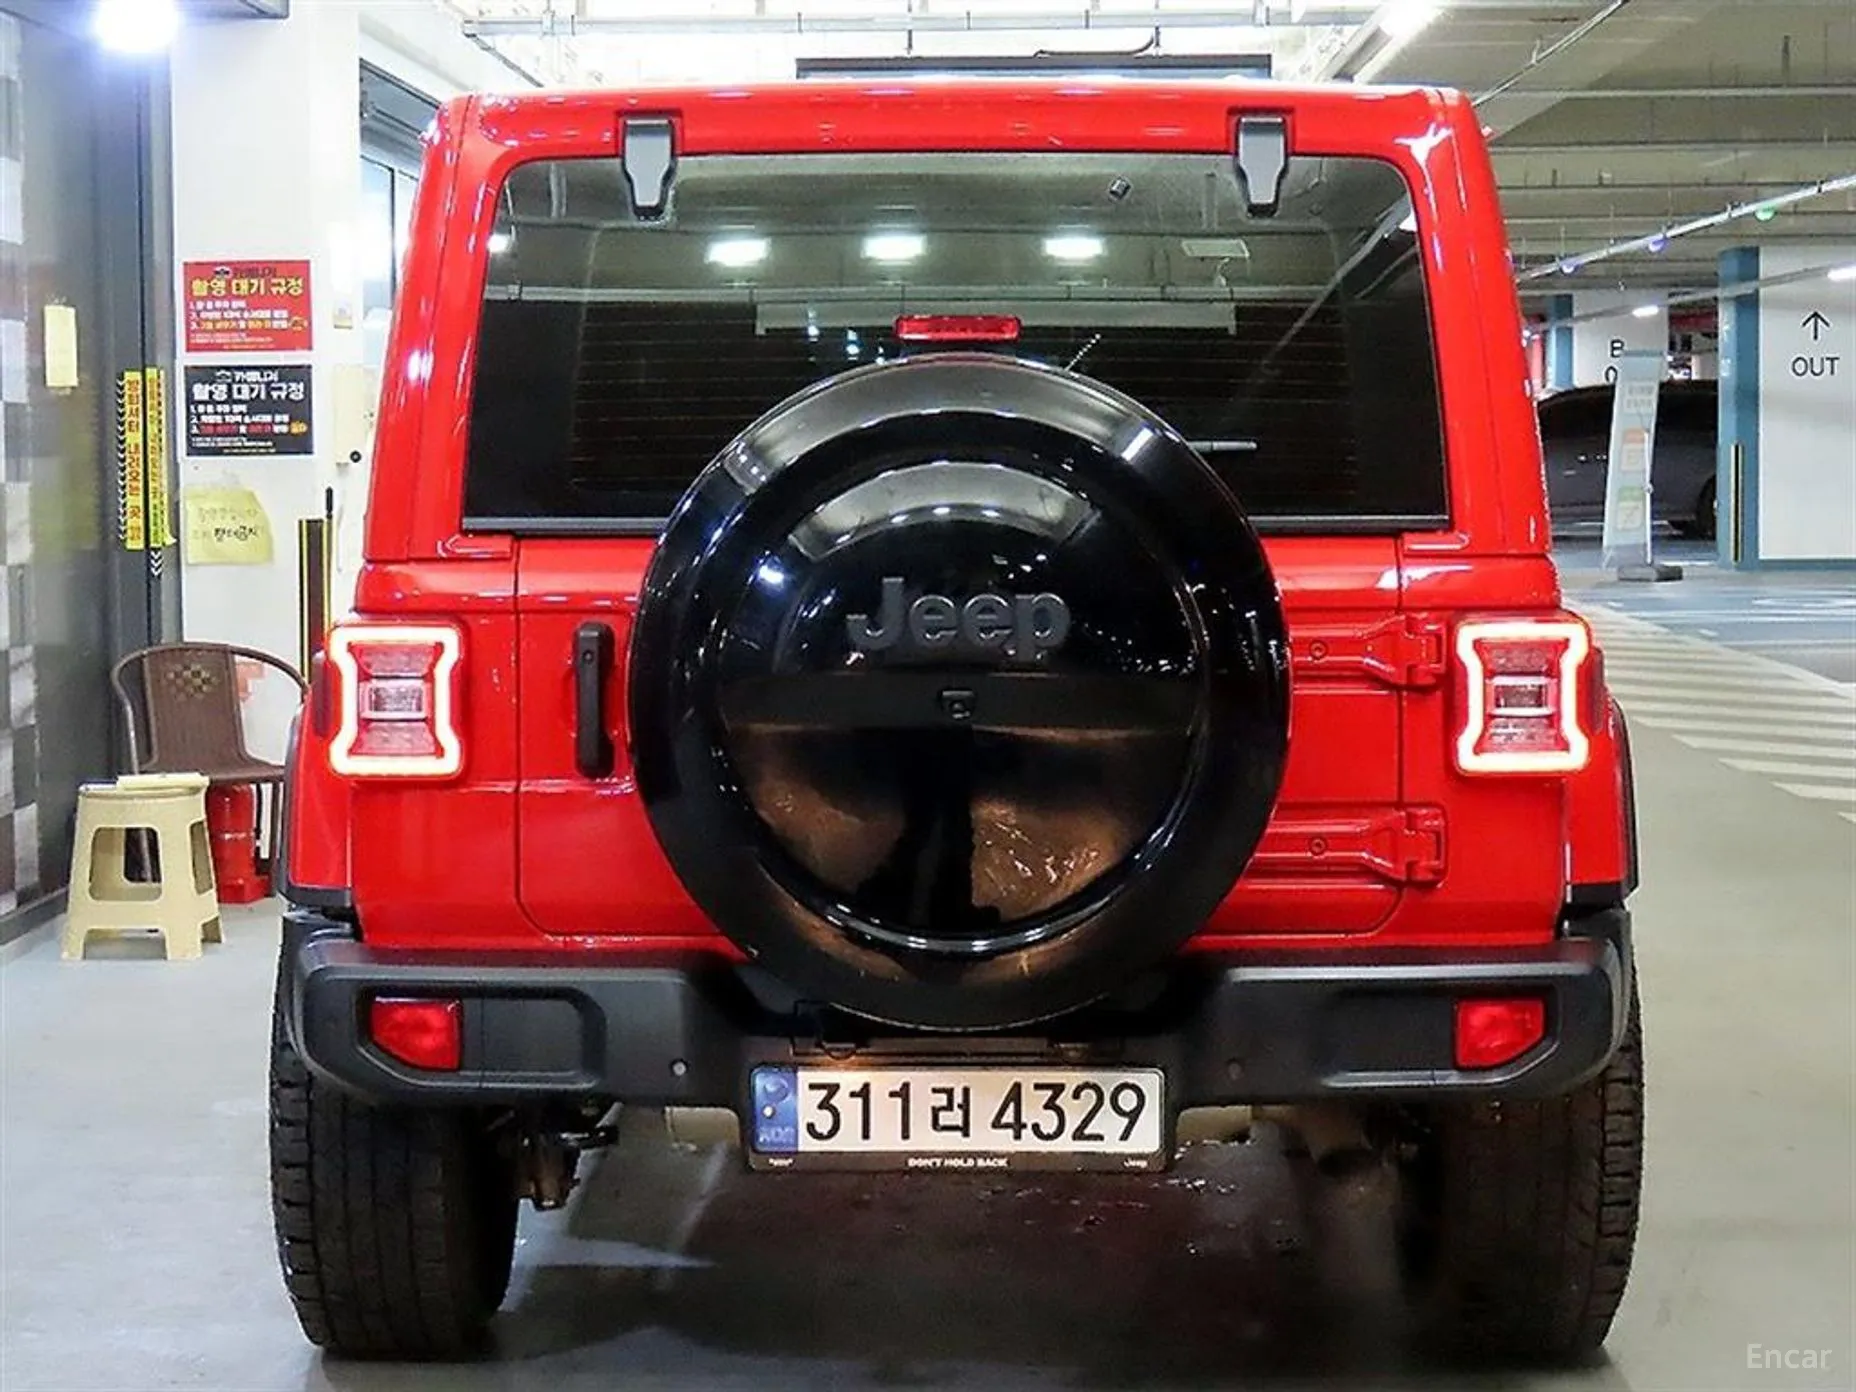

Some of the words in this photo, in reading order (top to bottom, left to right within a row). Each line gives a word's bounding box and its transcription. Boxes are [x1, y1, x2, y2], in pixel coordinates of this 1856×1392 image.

[231, 278, 265, 296] 대기
[271, 278, 304, 296] 규정
[1791, 356, 1840, 377] OUT
[232, 382, 266, 400] 대기
[270, 381, 305, 401] 규정
[846, 577, 1071, 662] Jeep
[990, 1081, 1148, 1142] 4329
[943, 1157, 975, 1168] HOLD
[977, 1157, 1009, 1168] BACK
